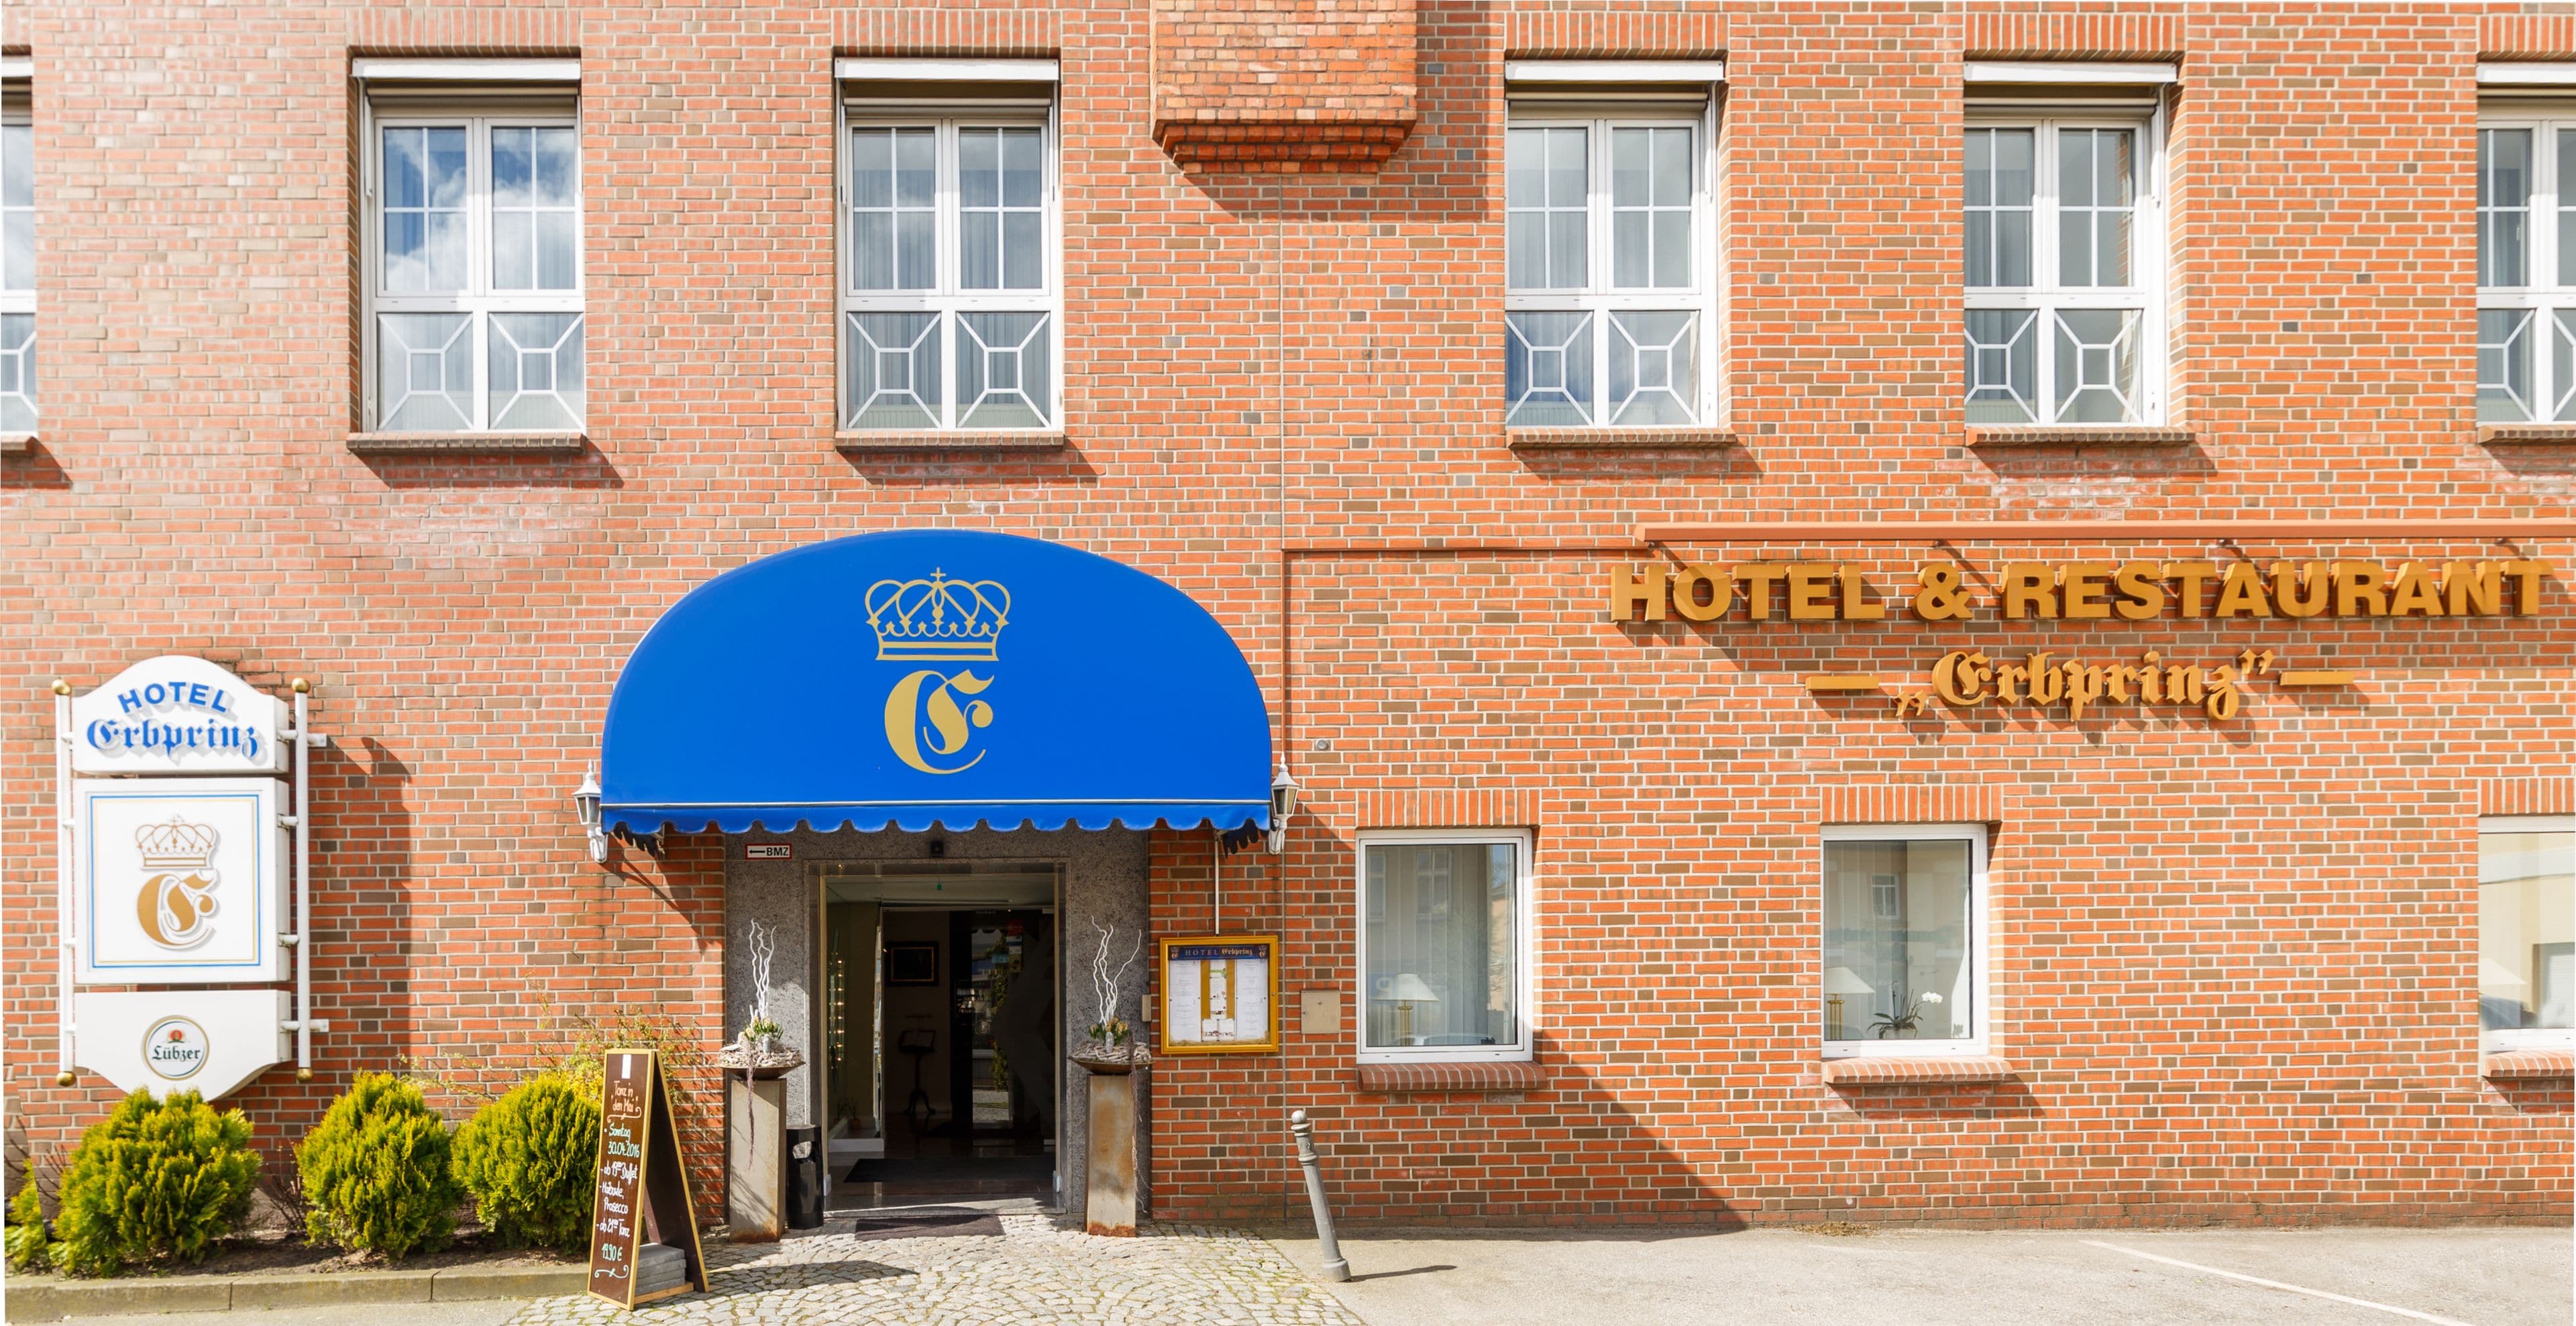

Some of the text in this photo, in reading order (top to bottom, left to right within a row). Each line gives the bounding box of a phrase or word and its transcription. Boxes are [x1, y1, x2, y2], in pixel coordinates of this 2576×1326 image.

[1611, 561, 2553, 622] HOTEL & RESTAURANT
[117, 681, 227, 714] HOTEL
[87, 718, 259, 759] Erbprinz
[766, 846, 790, 857] BMZ
[1222, 948, 1253, 956] Erbprinz
[152, 1045, 201, 1062] Lübzer
[628, 1083, 634, 1097] in
[604, 1197, 628, 1214] Prosecco
